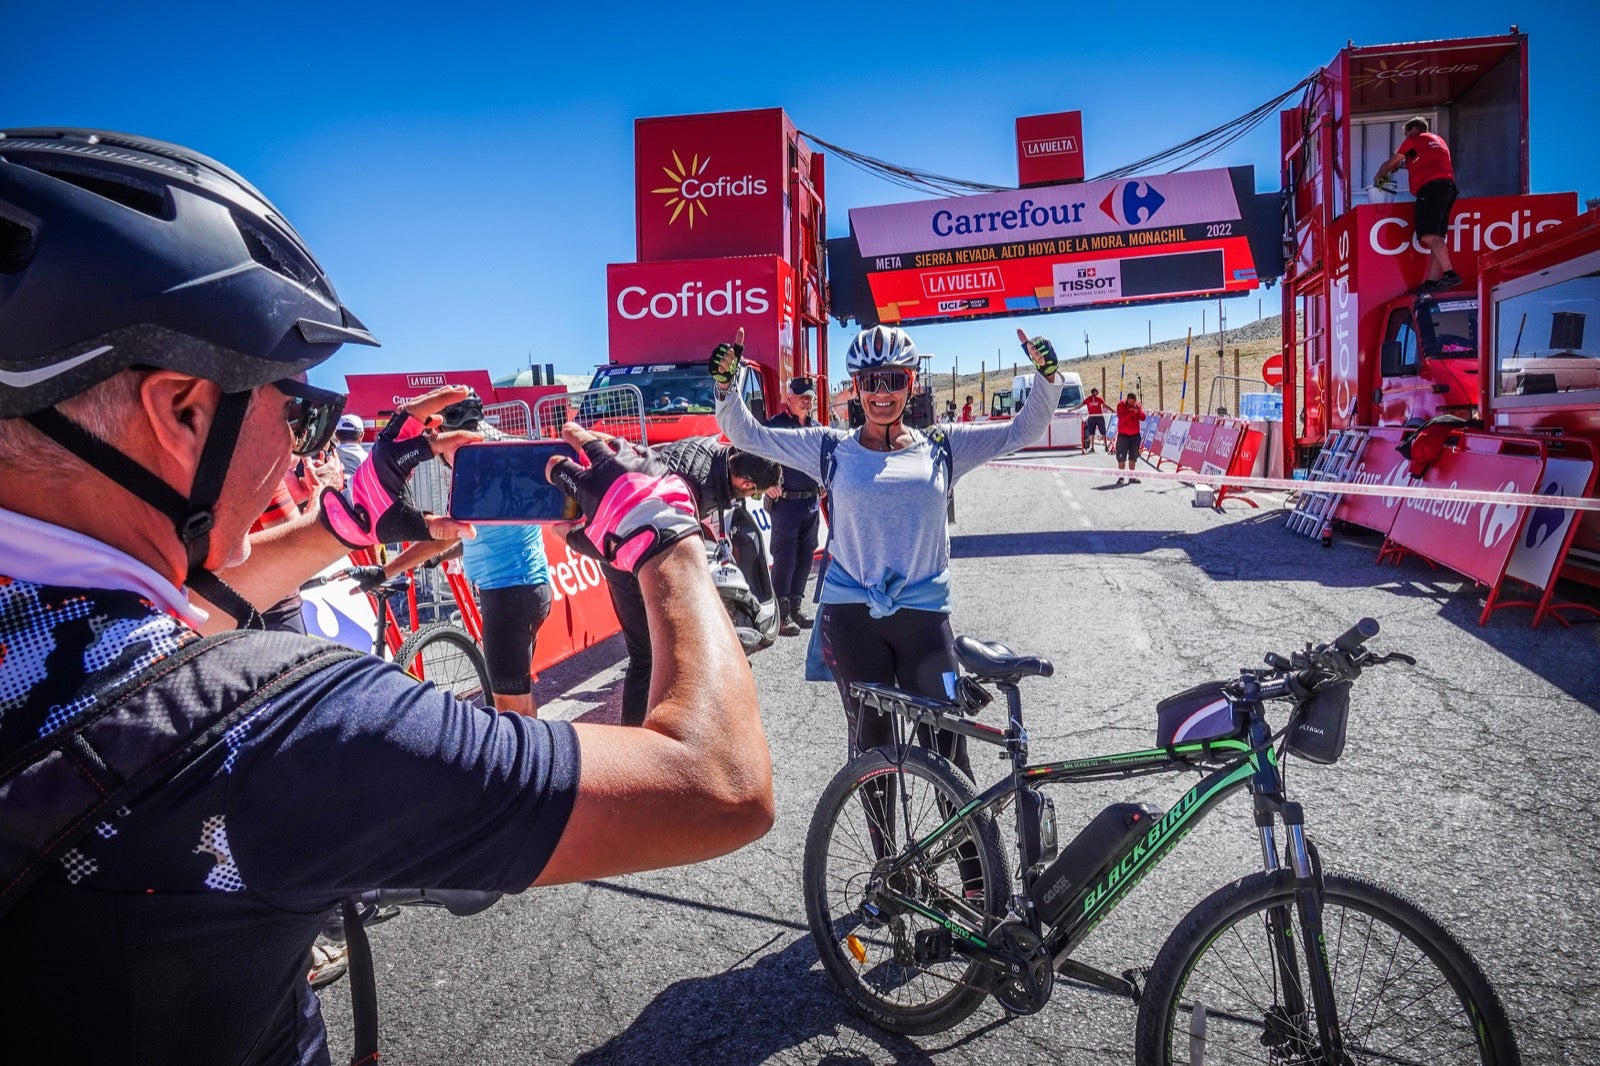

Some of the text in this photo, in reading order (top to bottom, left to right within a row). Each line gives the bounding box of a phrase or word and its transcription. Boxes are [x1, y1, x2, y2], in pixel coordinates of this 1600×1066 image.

[1028, 140, 1072, 154] LA VUELTA
[681, 175, 767, 199] Cofidis
[932, 199, 1086, 237] Carrefour
[876, 223, 1232, 270] META SIERRA NEVADA. ALTO HOYA DE LA MORA. MONACHIL 2022
[929, 272, 996, 293] LA VUELTA
[1059, 277, 1116, 292] TISSOT
[616, 279, 769, 320] Cofidis
[940, 302, 958, 311] UCI
[1337, 230, 1350, 419] Cofidis
[411, 376, 443, 386] LA VUELTA
[1084, 787, 1198, 913] BLACKBIRD
